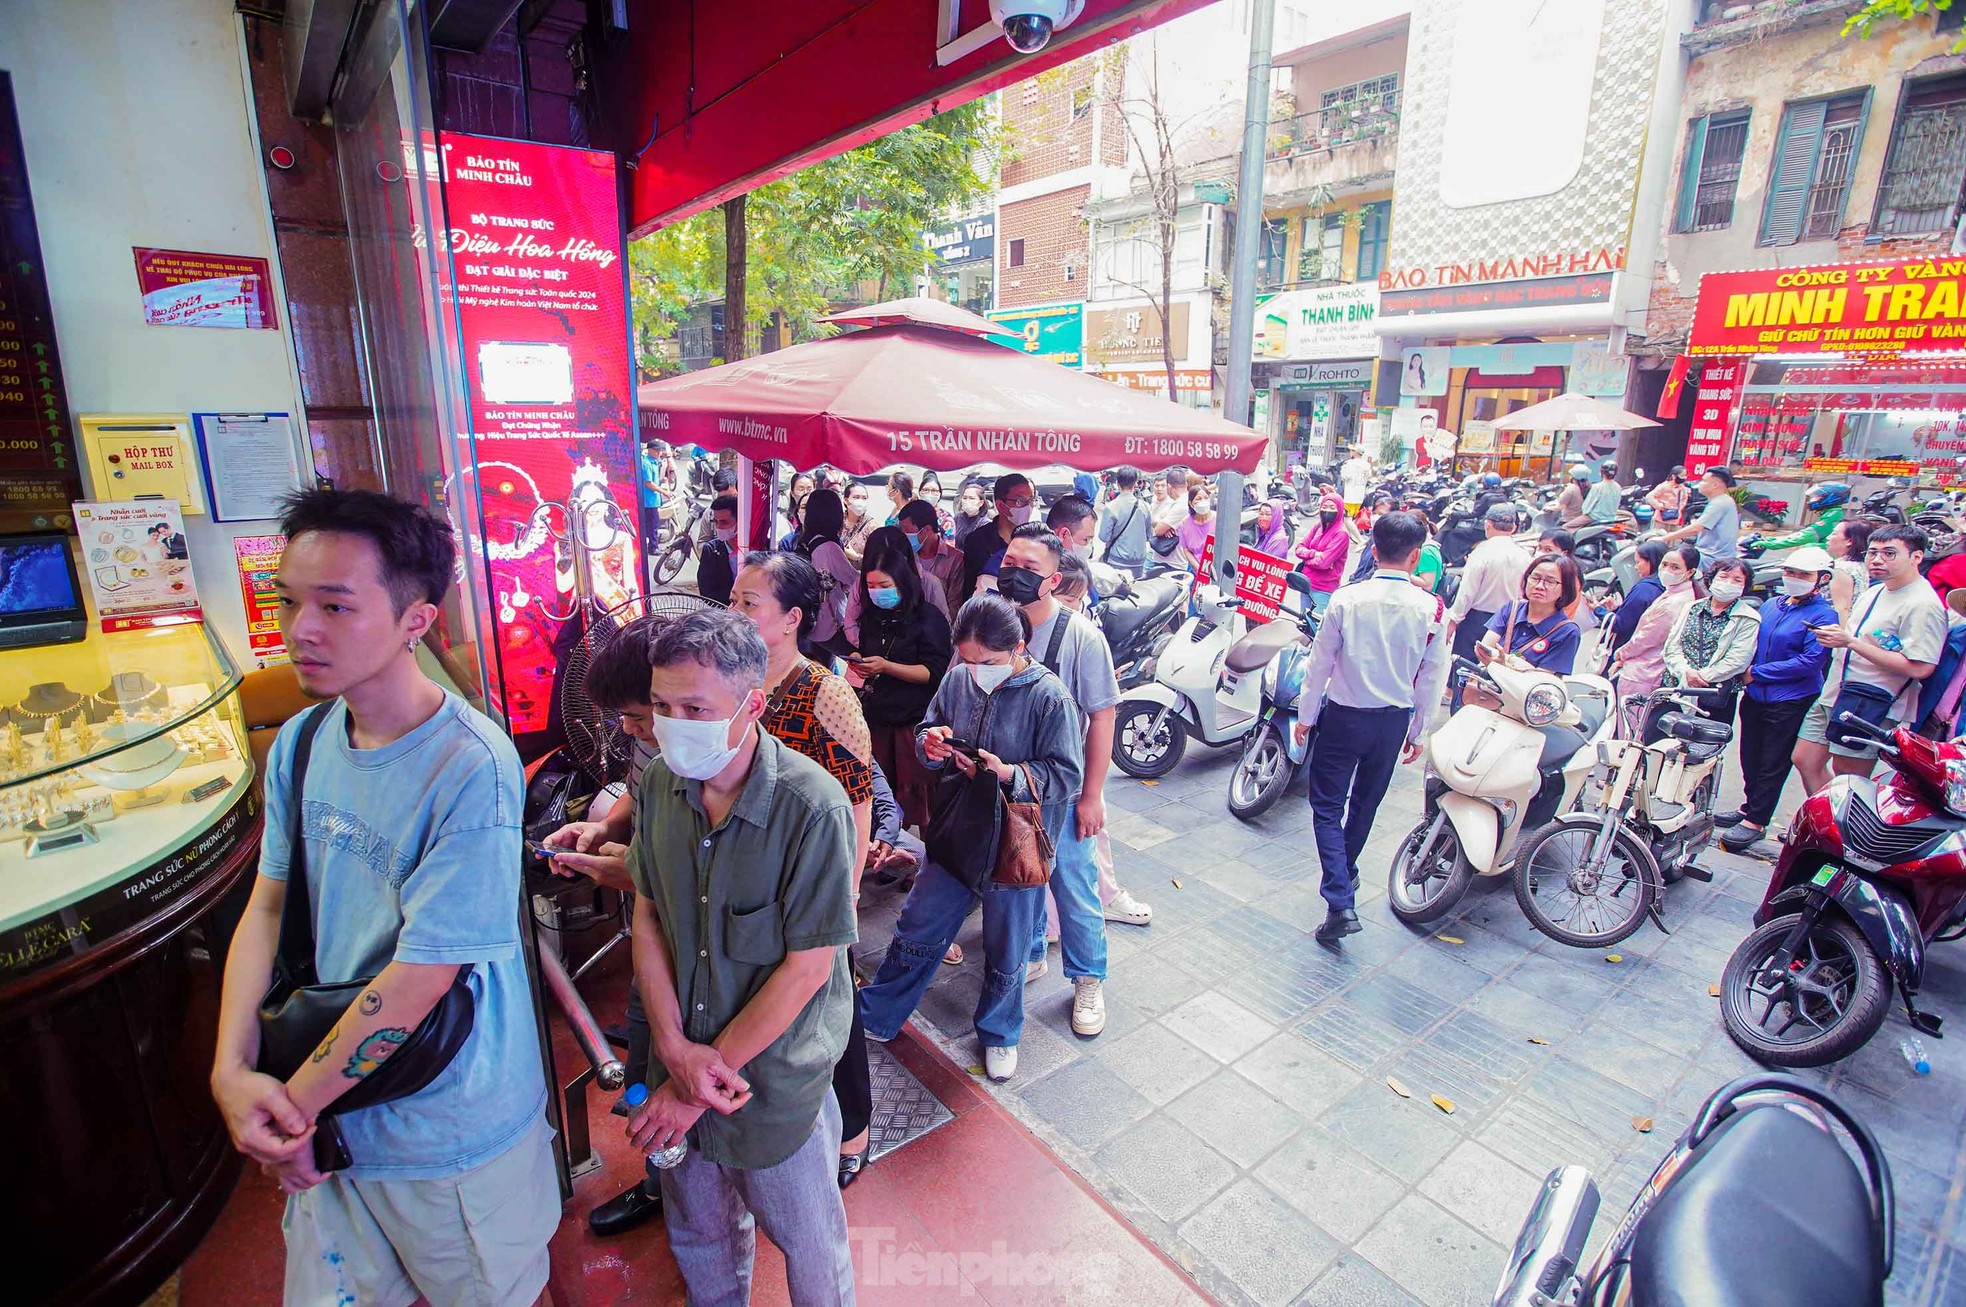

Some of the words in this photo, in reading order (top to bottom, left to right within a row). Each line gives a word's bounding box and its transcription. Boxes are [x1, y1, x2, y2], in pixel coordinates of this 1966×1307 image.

[467, 155, 495, 169] BẢO
[497, 159, 520, 172] TÍN
[456, 169, 494, 183] MINH
[495, 172, 533, 187] CHÂU
[470, 213, 487, 226] BỘ
[489, 216, 529, 229] TRANG
[531, 217, 555, 231] SỨC
[965, 220, 994, 240] Vân
[556, 237, 617, 269] Hồng
[1776, 269, 1849, 288] CÔNG
[1855, 266, 1896, 283] TY
[1903, 258, 1966, 280] VÀN
[578, 290, 597, 299] 2024
[1317, 292, 1334, 301] NHÀ
[1724, 287, 1849, 328] MINH
[1863, 280, 1966, 322] TRA
[1301, 305, 1344, 326] THANH
[1758, 326, 1786, 343] GIỮ
[1787, 326, 1821, 342] CHỮ
[1823, 325, 1853, 342] TÍN
[1854, 325, 1891, 341] HƠN
[1894, 323, 1928, 339] GIỮ
[1931, 320, 1966, 338] VÀN
[1705, 365, 1724, 381] THIẾT
[1723, 366, 1737, 380] KẾ
[1698, 388, 1720, 400] TRANG
[1719, 386, 1733, 400] SỨC
[524, 411, 549, 420] MINH
[649, 408, 670, 430] TÔNG
[1703, 409, 1719, 420] 3D
[718, 416, 788, 444] www.btmc.vn
[886, 431, 913, 452] 15
[915, 424, 972, 451] TRẦN
[977, 427, 1032, 452] NHÂN
[1034, 429, 1081, 452] TÔNG
[1693, 428, 1706, 440] THU
[1706, 428, 1723, 440] MUA
[124, 447, 147, 461] HỘP
[151, 446, 174, 458] THƯ
[1124, 436, 1149, 455] ĐT:
[1152, 438, 1184, 457] 1800
[1187, 440, 1203, 458] 58
[1205, 442, 1222, 459] 58
[1223, 443, 1239, 461] 99
[1689, 443, 1707, 456] VÀNG
[1707, 443, 1720, 456] TÂY
[131, 462, 153, 470] MAIL
[155, 461, 174, 469] BOX
[1251, 557, 1265, 572] VUI
[1265, 565, 1288, 580] LÒNG
[1245, 574, 1266, 593] ĐỂ
[1264, 581, 1284, 601] XE
[123, 870, 165, 900] TRANG
[165, 856, 186, 877] SỨC
[185, 846, 198, 864] NỮ
[199, 829, 223, 855] PHONG
[222, 816, 237, 834] CÁCH
[151, 886, 172, 903] TRANG
